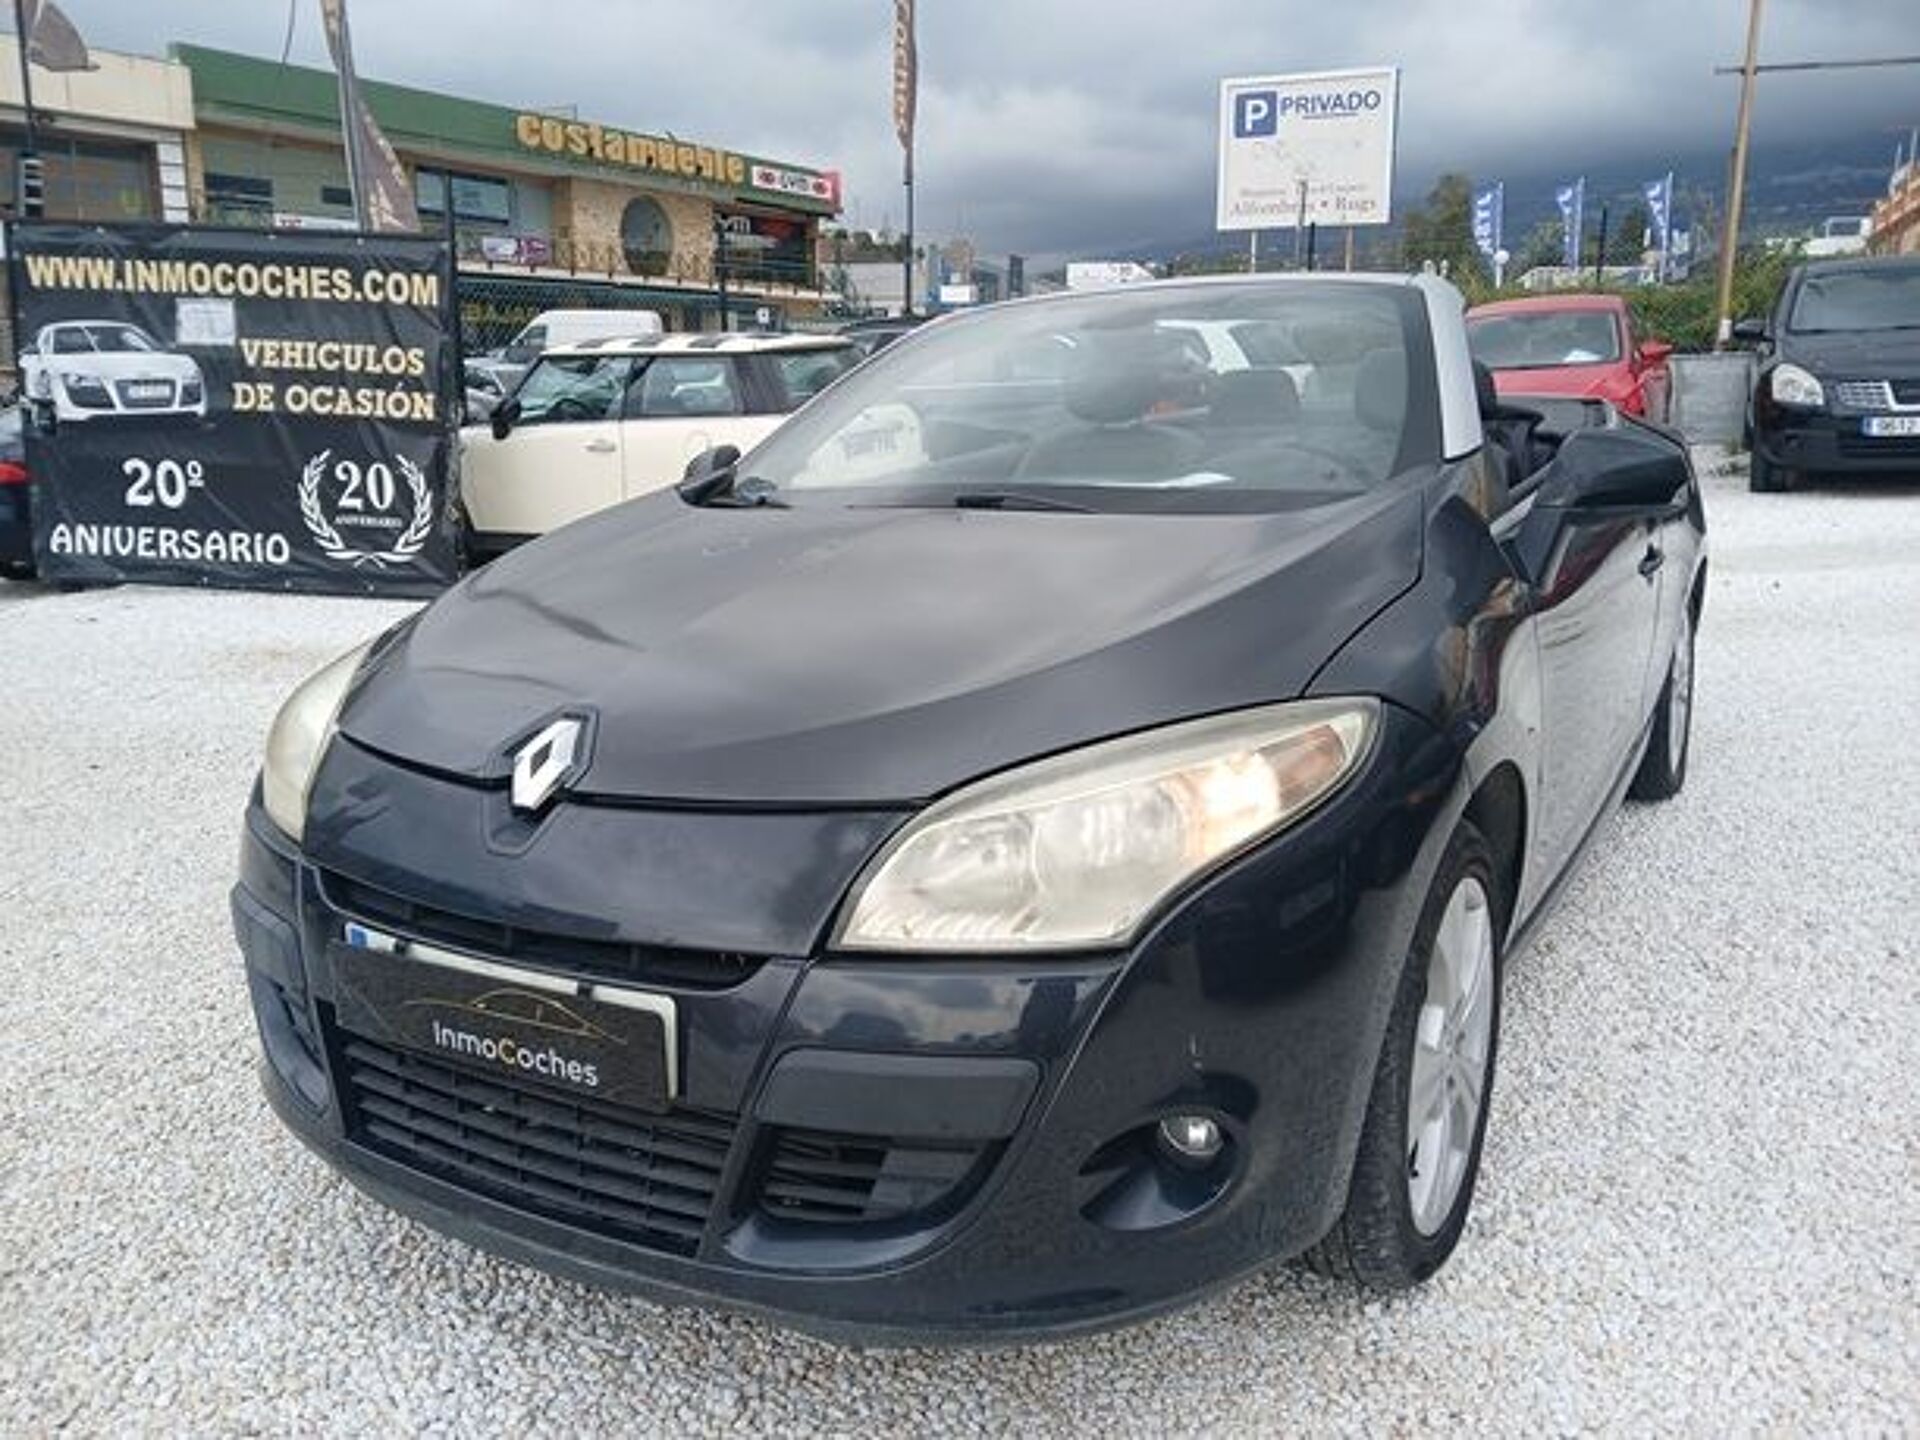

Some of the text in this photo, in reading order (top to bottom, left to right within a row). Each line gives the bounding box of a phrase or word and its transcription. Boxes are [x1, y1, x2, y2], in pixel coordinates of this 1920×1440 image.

[1280, 90, 1381, 115] PRIVADO
[26, 256, 438, 304] WWW.INMOCOCHES.COM
[240, 338, 426, 376] VEHICULOS
[232, 381, 436, 420] DE OCASIÓN
[335, 462, 397, 517] 20
[432, 1019, 600, 1086] InmoCoches
